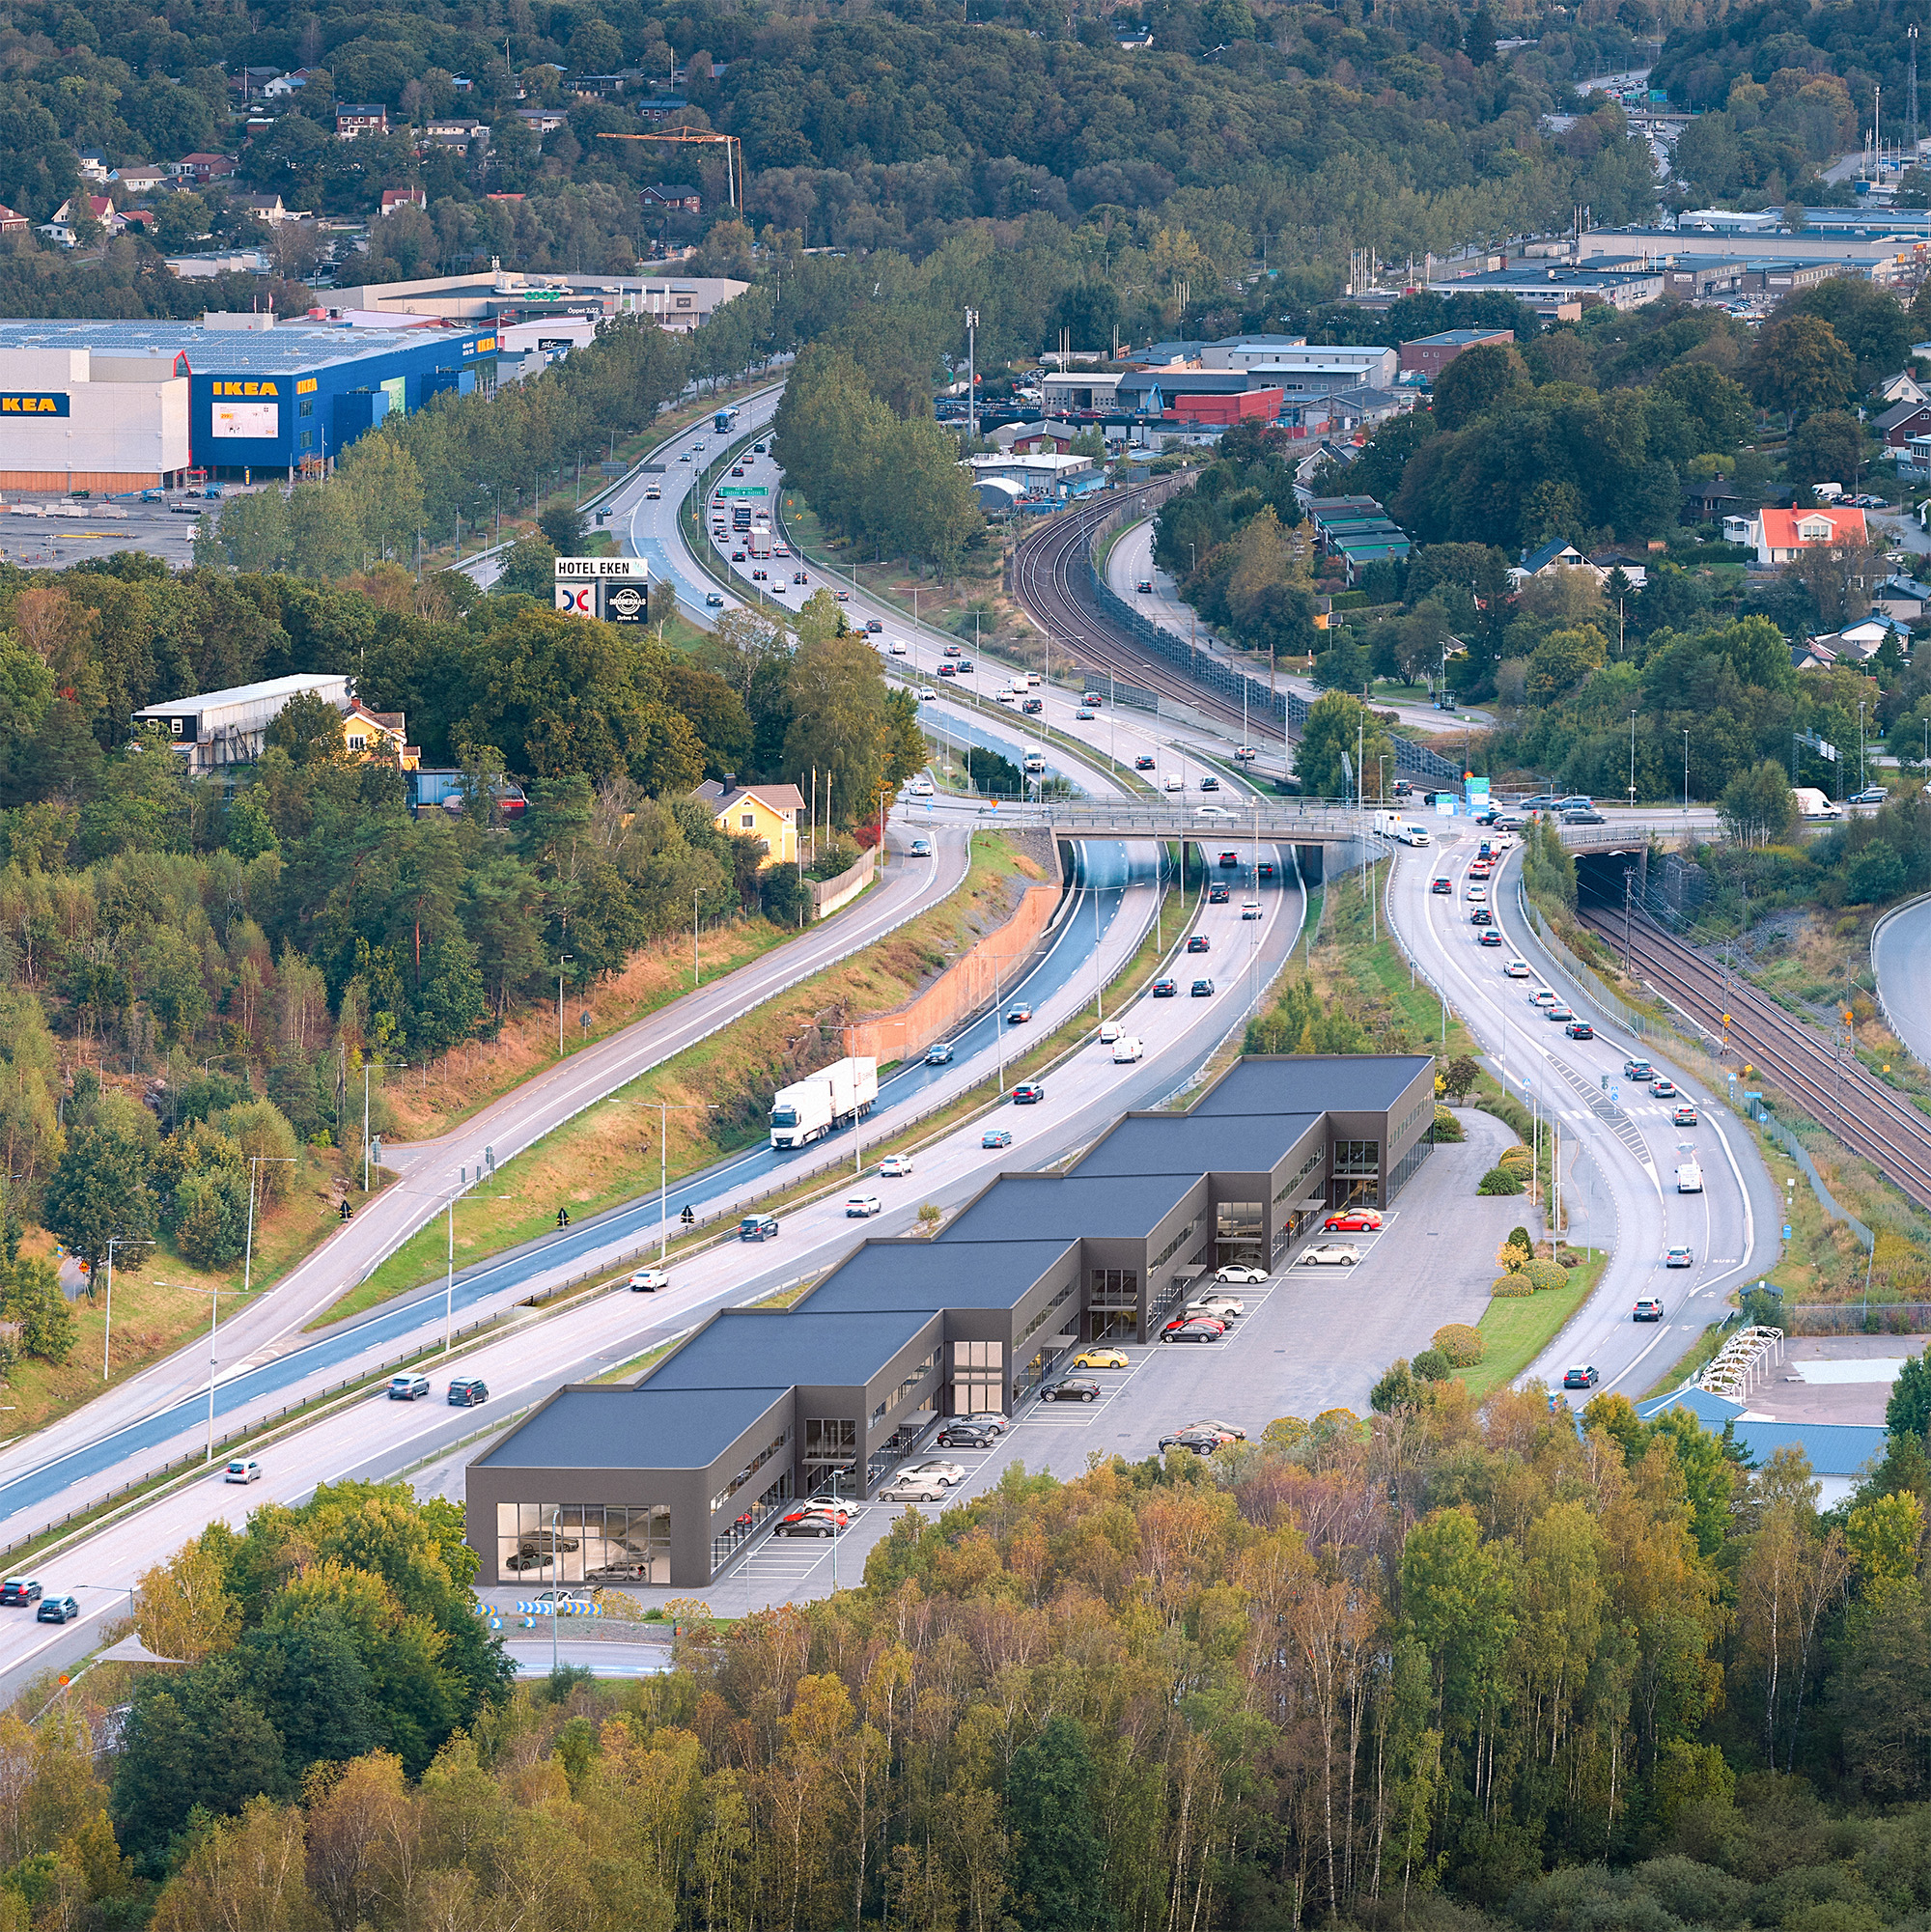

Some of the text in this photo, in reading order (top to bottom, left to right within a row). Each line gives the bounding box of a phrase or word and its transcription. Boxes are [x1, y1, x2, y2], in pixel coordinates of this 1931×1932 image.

[524, 291, 560, 302] coop
[477, 338, 495, 352] IKEA
[212, 381, 278, 396] IKEA
[295, 378, 318, 395] IKEA
[2, 398, 57, 411] KEA
[558, 562, 630, 574] HOTEL EKEN
